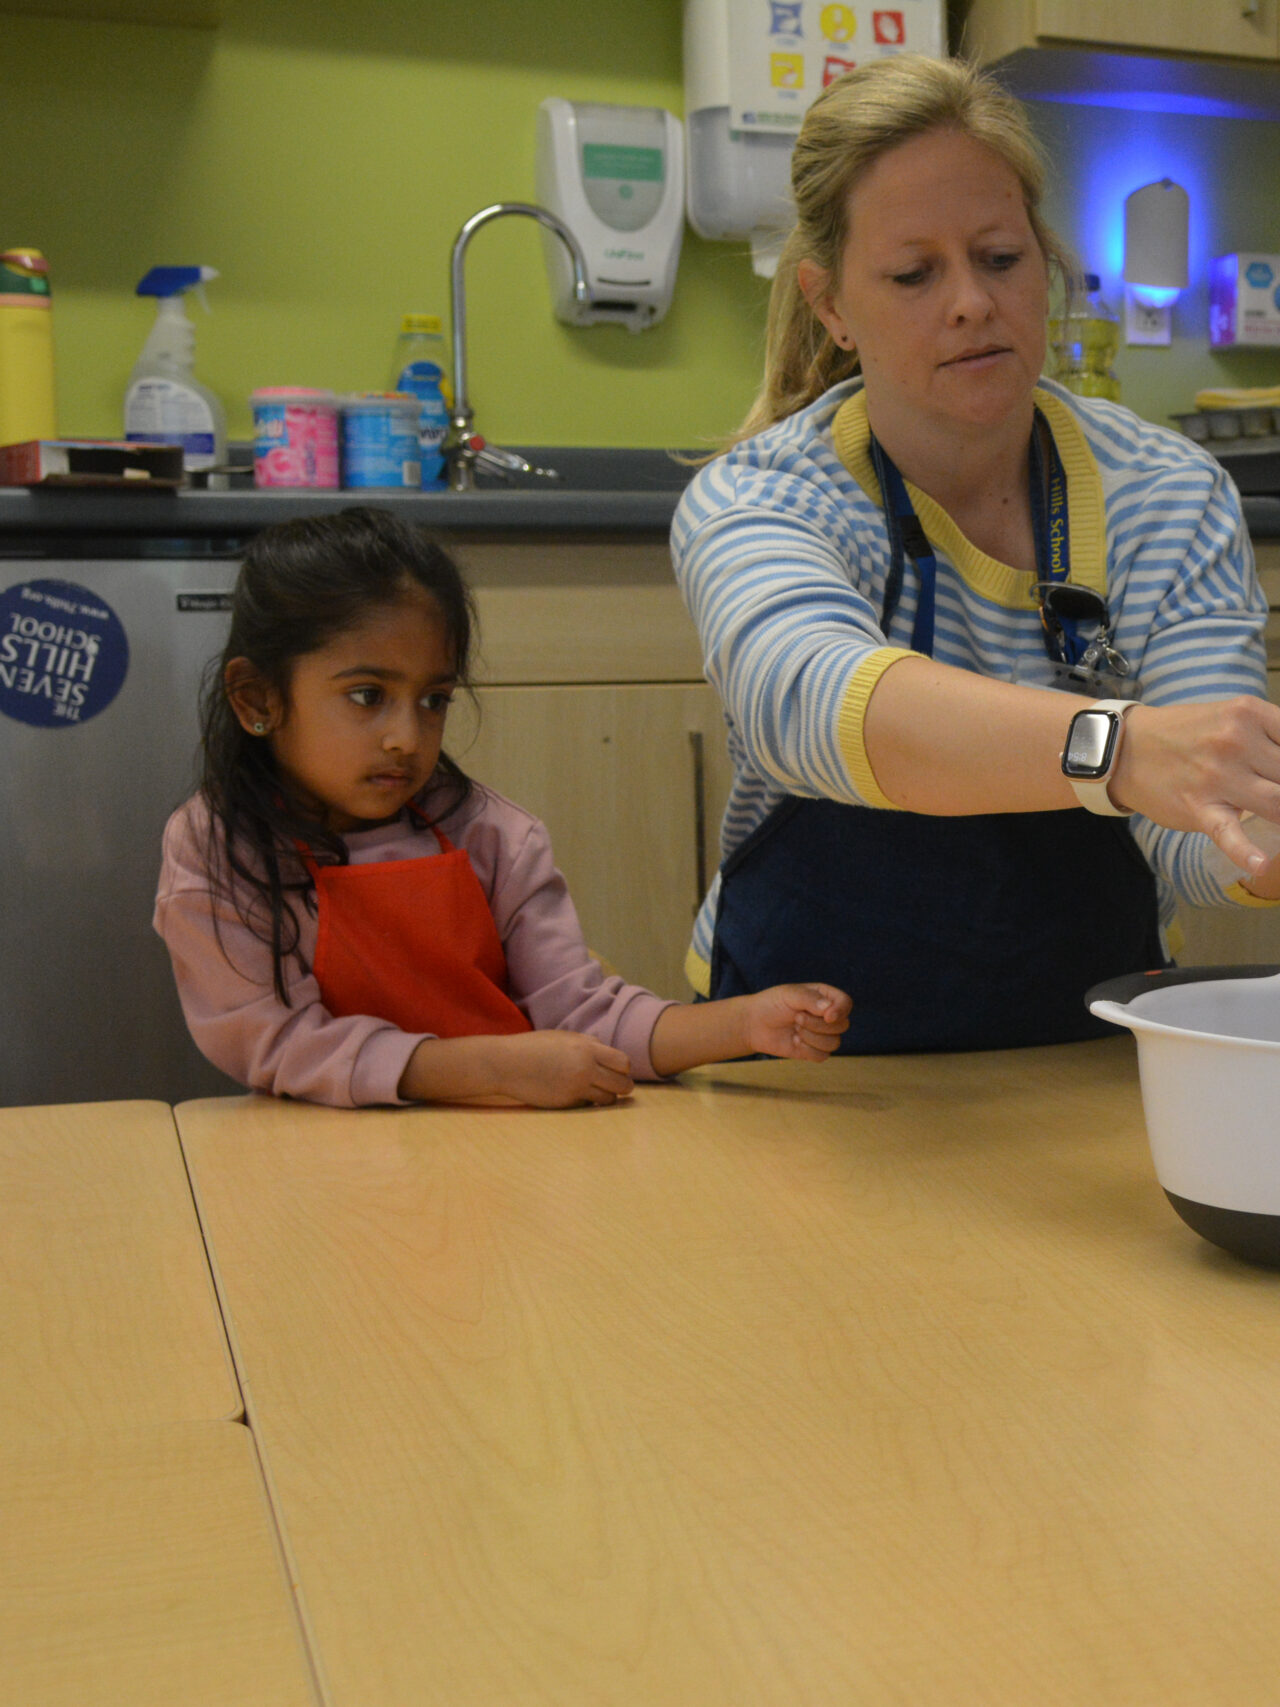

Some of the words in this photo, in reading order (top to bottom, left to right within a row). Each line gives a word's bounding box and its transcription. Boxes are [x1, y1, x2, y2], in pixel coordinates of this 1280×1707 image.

[1050, 476, 1064, 515] Hills
[1050, 518, 1067, 574] School
[0, 632, 97, 683] HILLS
[9, 612, 103, 657] SCHOOL
[0, 661, 90, 708] SEVEN
[53, 700, 82, 722] THE
